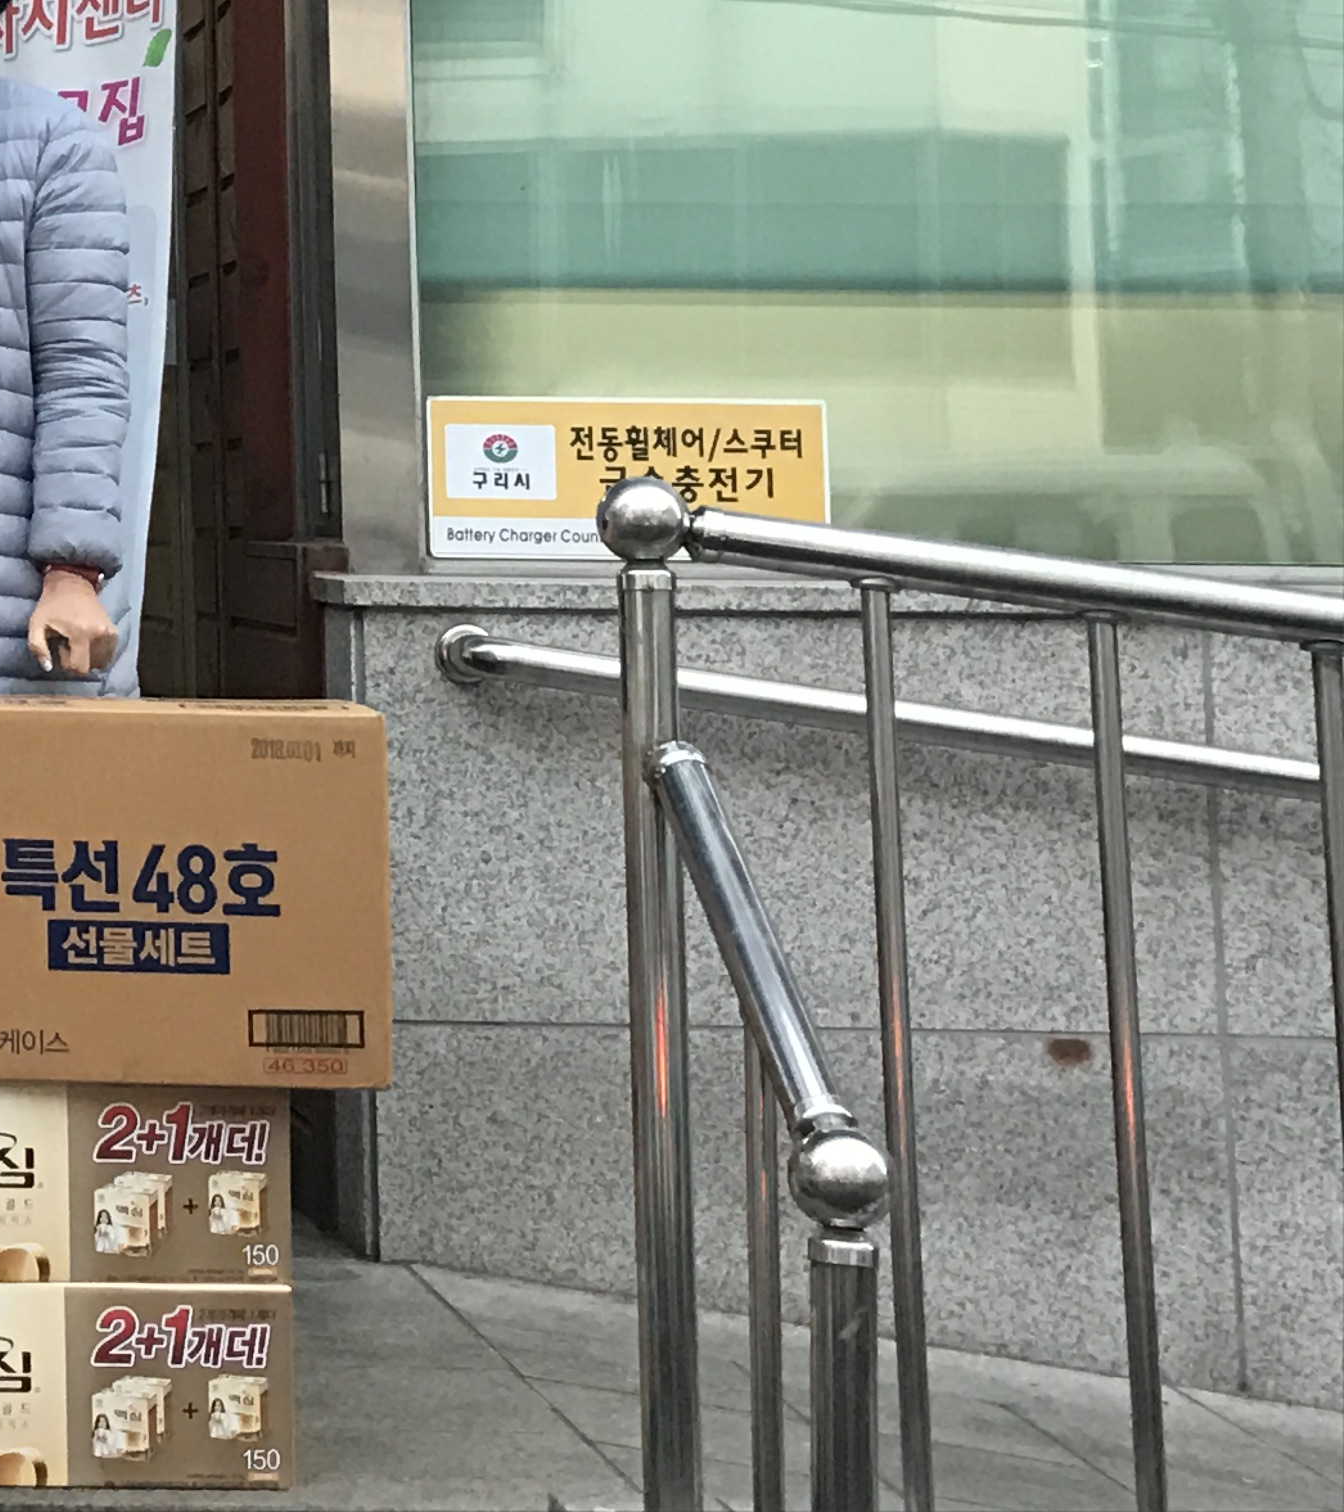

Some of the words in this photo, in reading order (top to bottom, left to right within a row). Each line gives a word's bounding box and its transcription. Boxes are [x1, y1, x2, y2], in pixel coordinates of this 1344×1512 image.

[569, 425, 803, 462] 전동휠체어/스쿠터
[472, 472, 531, 490] 구리시
[447, 527, 495, 544] Battery
[499, 528, 557, 544] Charger
[560, 529, 604, 543] Coun
[61, 927, 215, 966] 선물세트
[242, 1244, 279, 1266] 150
[243, 1448, 281, 1471] 150
